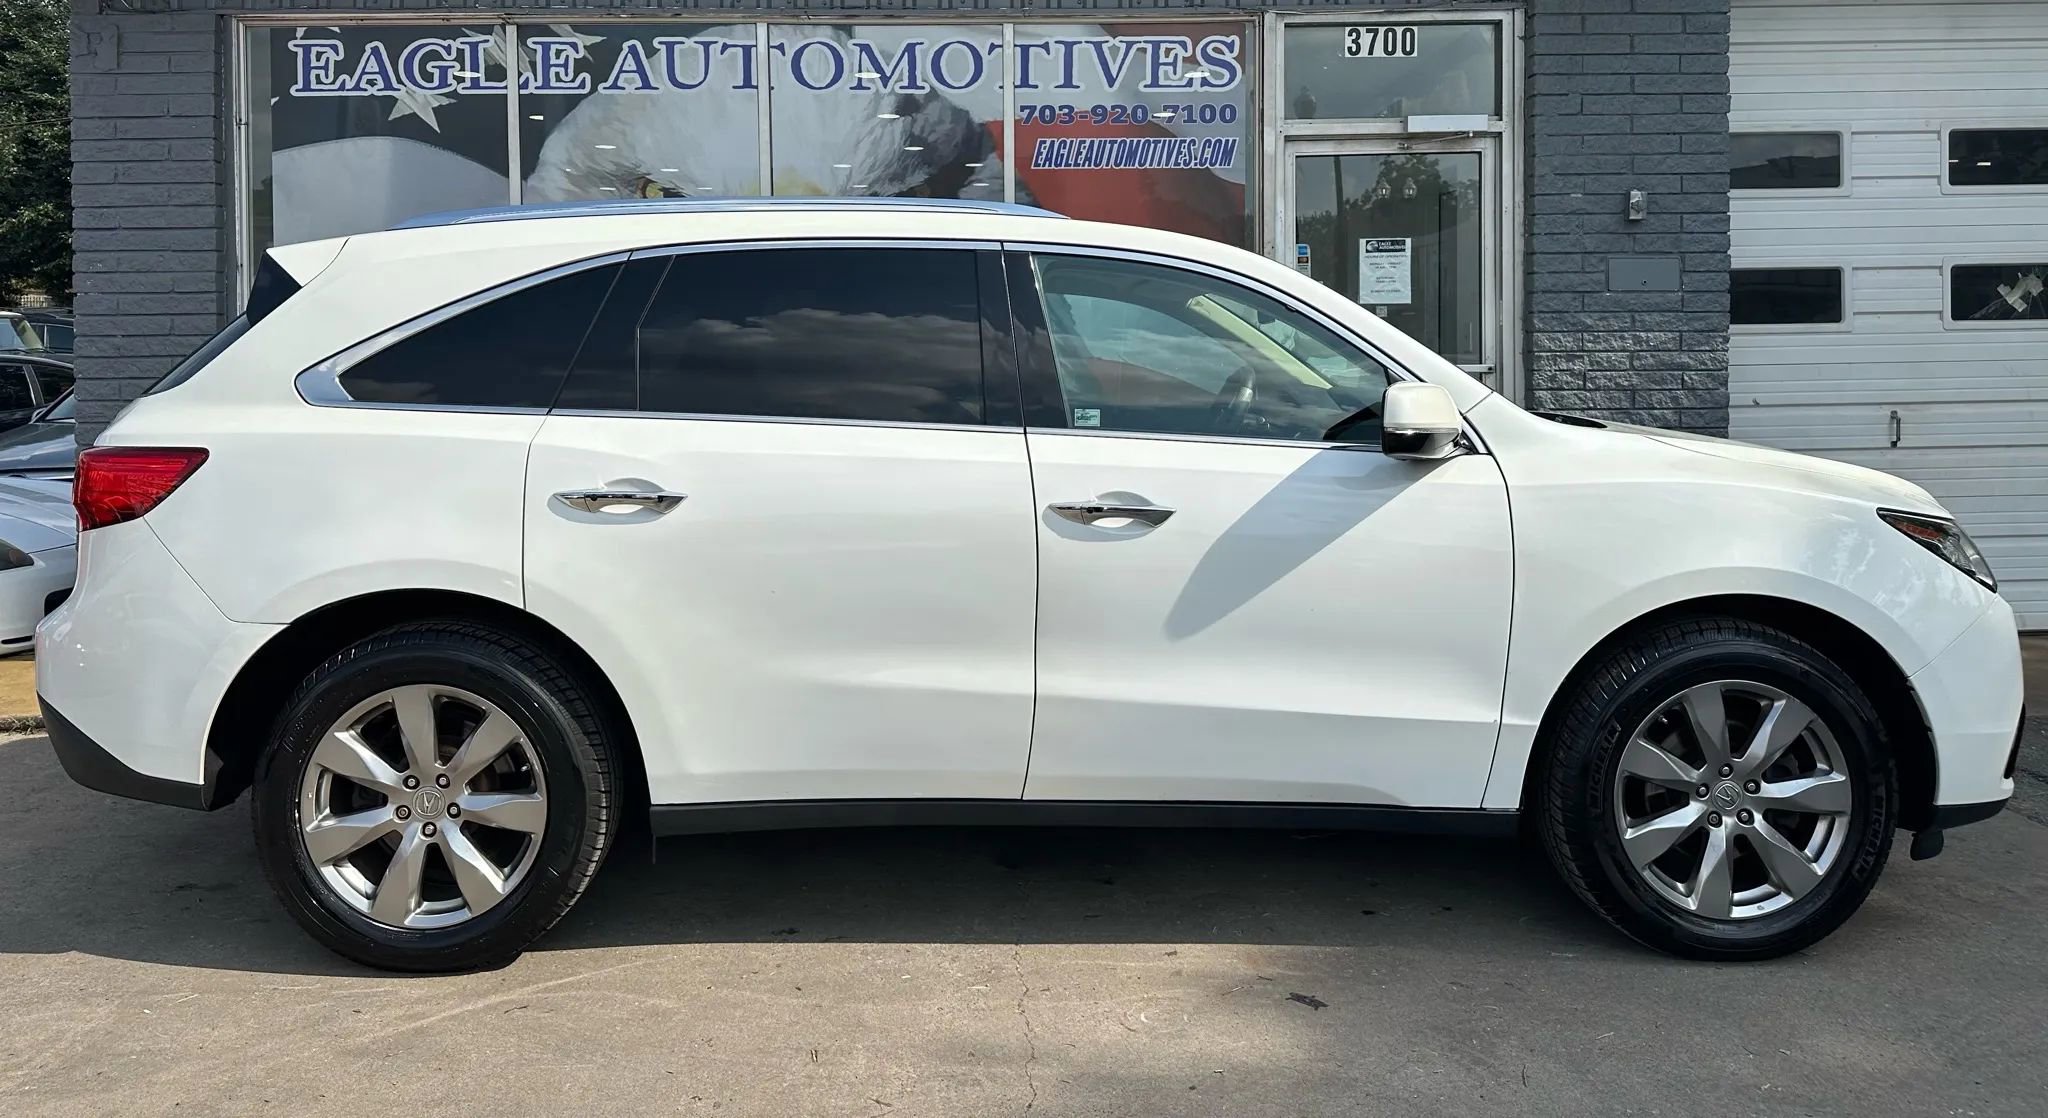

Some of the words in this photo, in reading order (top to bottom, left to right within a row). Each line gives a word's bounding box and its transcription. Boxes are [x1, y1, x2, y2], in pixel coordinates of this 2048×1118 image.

[1346, 27, 1417, 57] 3700
[290, 38, 590, 95] EAGLE
[599, 35, 1242, 93] AUTOMOTIVES
[1019, 103, 1238, 126] 703-920-7100
[1031, 137, 1238, 169] EAGLEAUTOMOTIVES.COM
